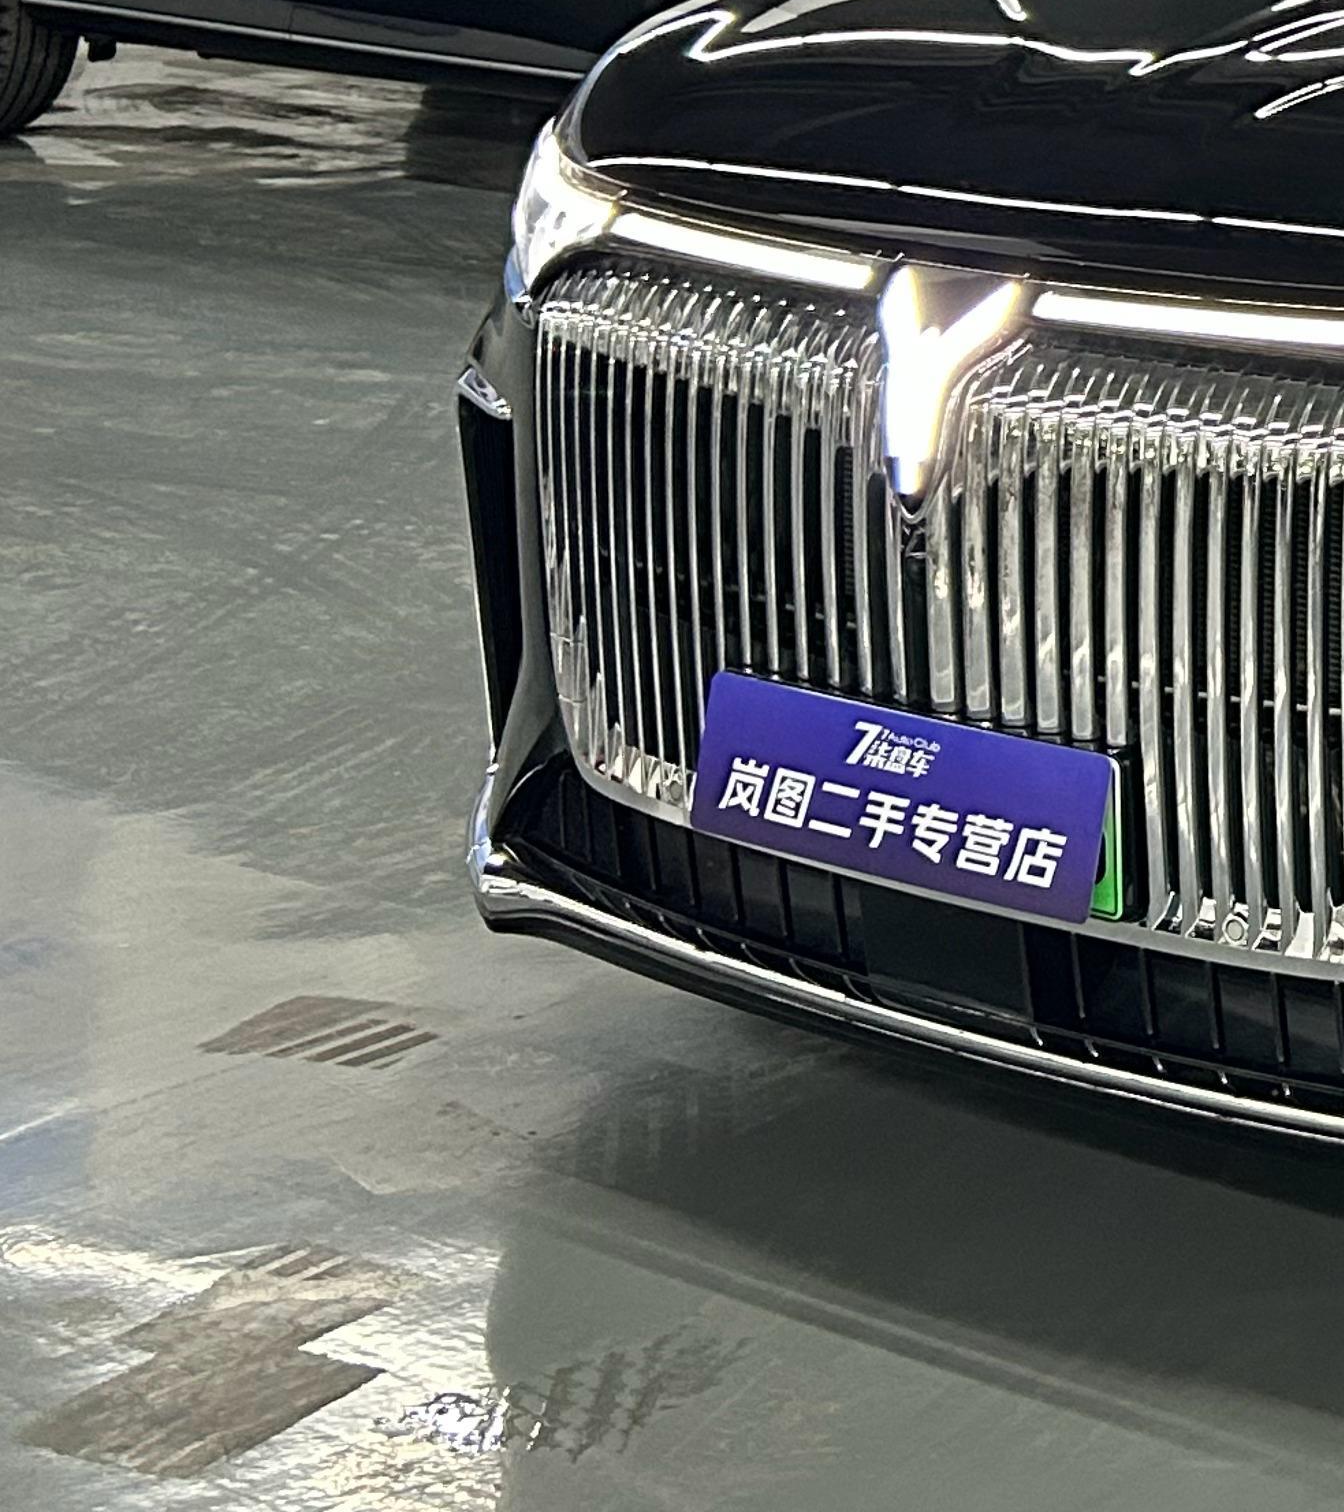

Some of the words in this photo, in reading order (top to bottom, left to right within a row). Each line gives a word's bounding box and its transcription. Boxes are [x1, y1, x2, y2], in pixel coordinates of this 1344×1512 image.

[862, 740, 936, 778] 柒盘车
[717, 756, 1068, 888] 岚图二手专营店
